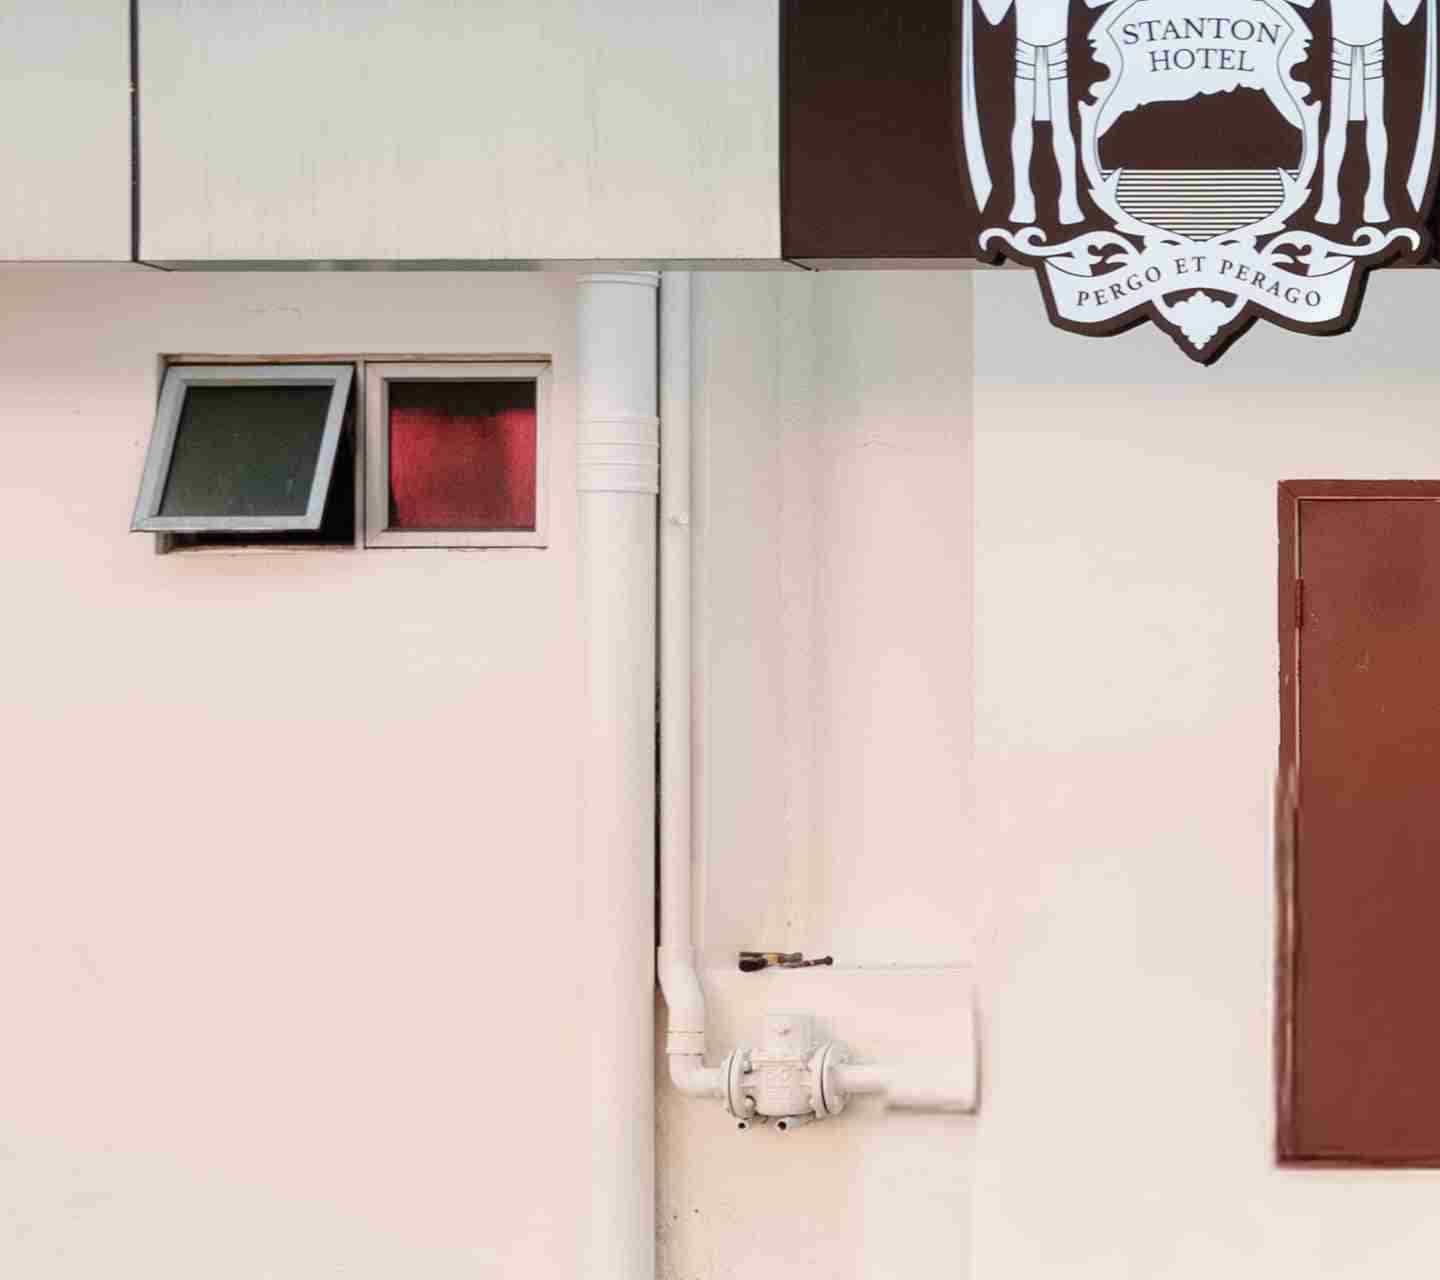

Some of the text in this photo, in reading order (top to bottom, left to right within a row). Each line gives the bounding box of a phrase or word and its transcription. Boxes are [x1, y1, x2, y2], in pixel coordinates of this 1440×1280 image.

[1122, 17, 1281, 45] STANTON
[1149, 48, 1255, 72] HOTEL
[1076, 256, 1321, 307] PERGO ET PERAGO
